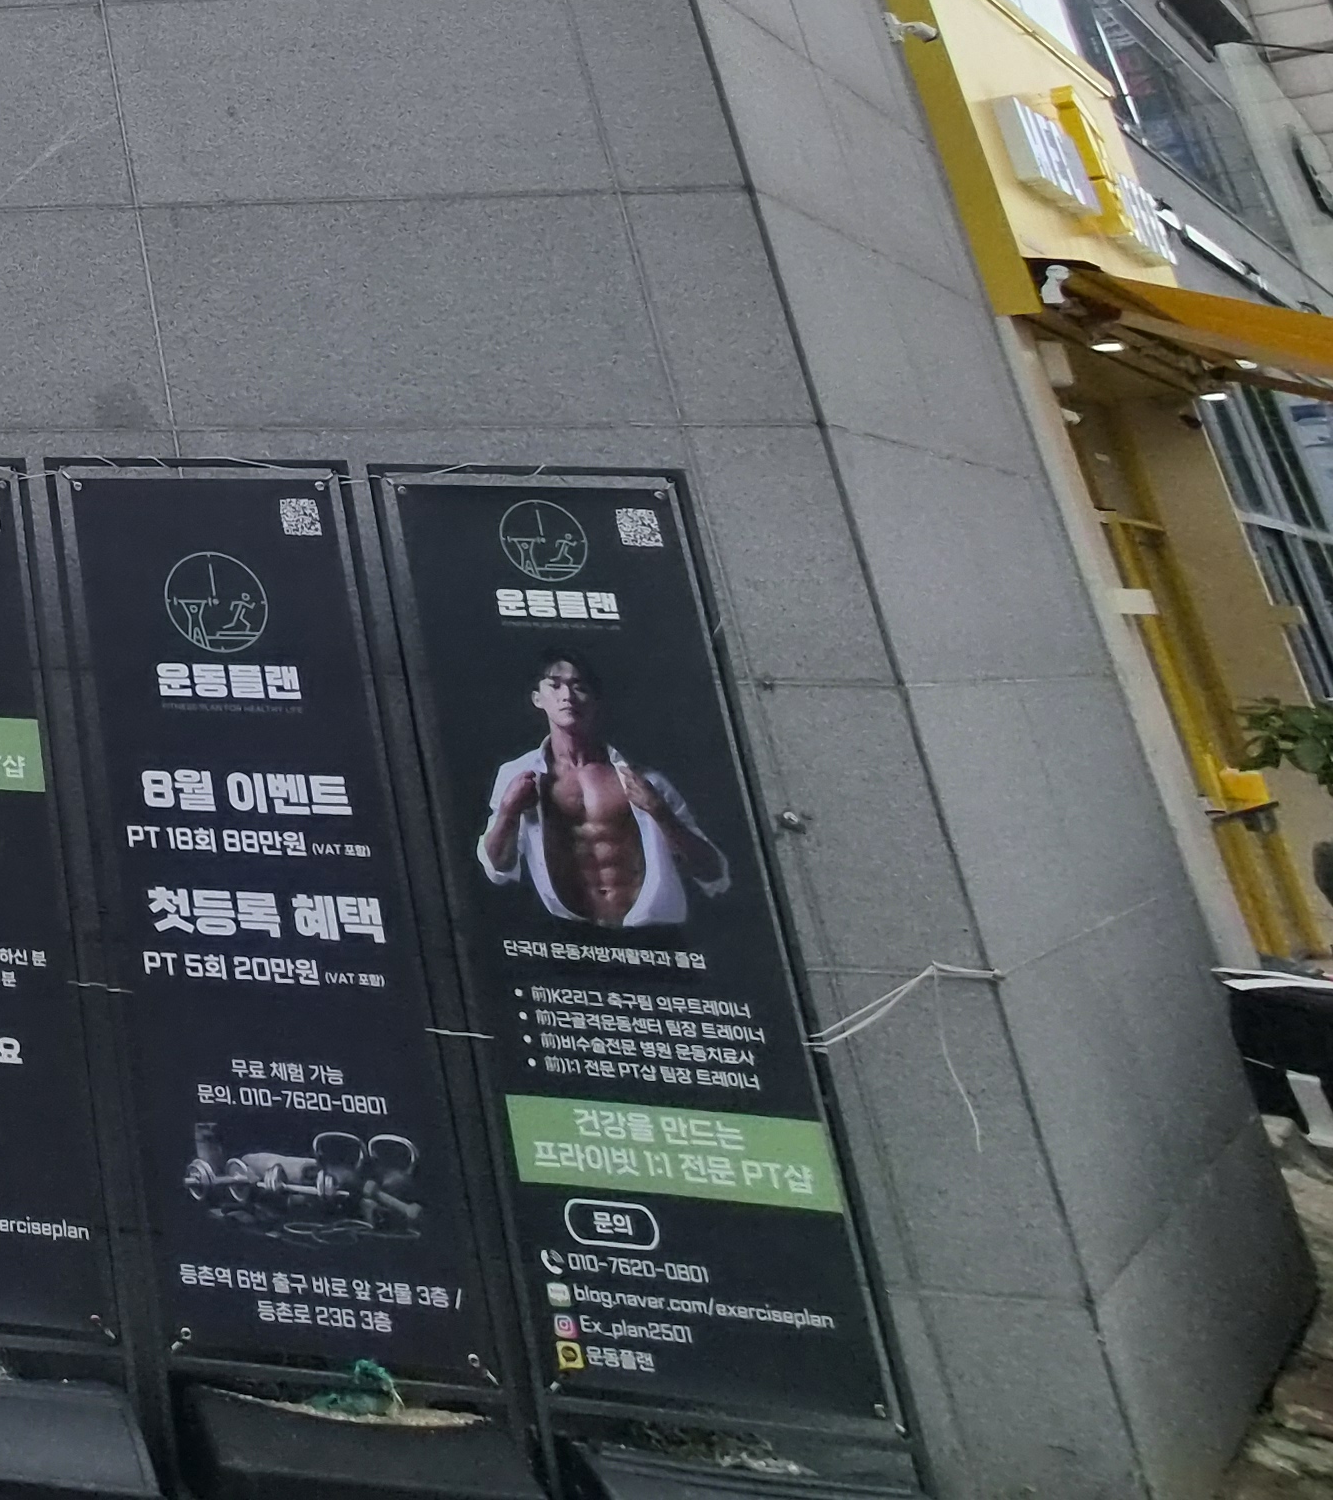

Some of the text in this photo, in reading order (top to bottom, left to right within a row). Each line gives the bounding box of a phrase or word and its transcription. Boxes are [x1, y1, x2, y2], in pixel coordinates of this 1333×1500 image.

[141, 768, 353, 816] 8월 이벤트
[126, 825, 308, 857] PT 18회 88만원
[147, 886, 387, 944] 첫등록 혜택
[142, 951, 321, 987] PT 5회 20만원
[503, 939, 549, 958] 단국대
[674, 951, 707, 970] 졸업
[607, 991, 752, 1019] 축구팀 의무트레이너
[665, 1019, 765, 1045] 팀장 트레이너
[639, 1041, 756, 1067] 병원 운동치료사
[231, 1058, 345, 1086] 무료 체험 가능
[584, 1059, 761, 1092] 전문 PT샵 팀장 트레이너
[239, 1087, 389, 1116] 010-7620-0801
[573, 1108, 745, 1151] 건강을 만드는
[533, 1140, 814, 1196] 프라이빗 전문 PT샵
[592, 1211, 634, 1236] 문의
[568, 1253, 710, 1284] 010-7620-0801
[179, 1263, 450, 1309] 등촌역 6번 출구 바로 앞 건물 3층
[256, 1300, 393, 1333] 등촌로 236 3층
[573, 1283, 836, 1330] blog.naver.com/exerciseplan
[579, 1314, 693, 1344] Ex_plan2501
[586, 1345, 657, 1373] 운동플랜
